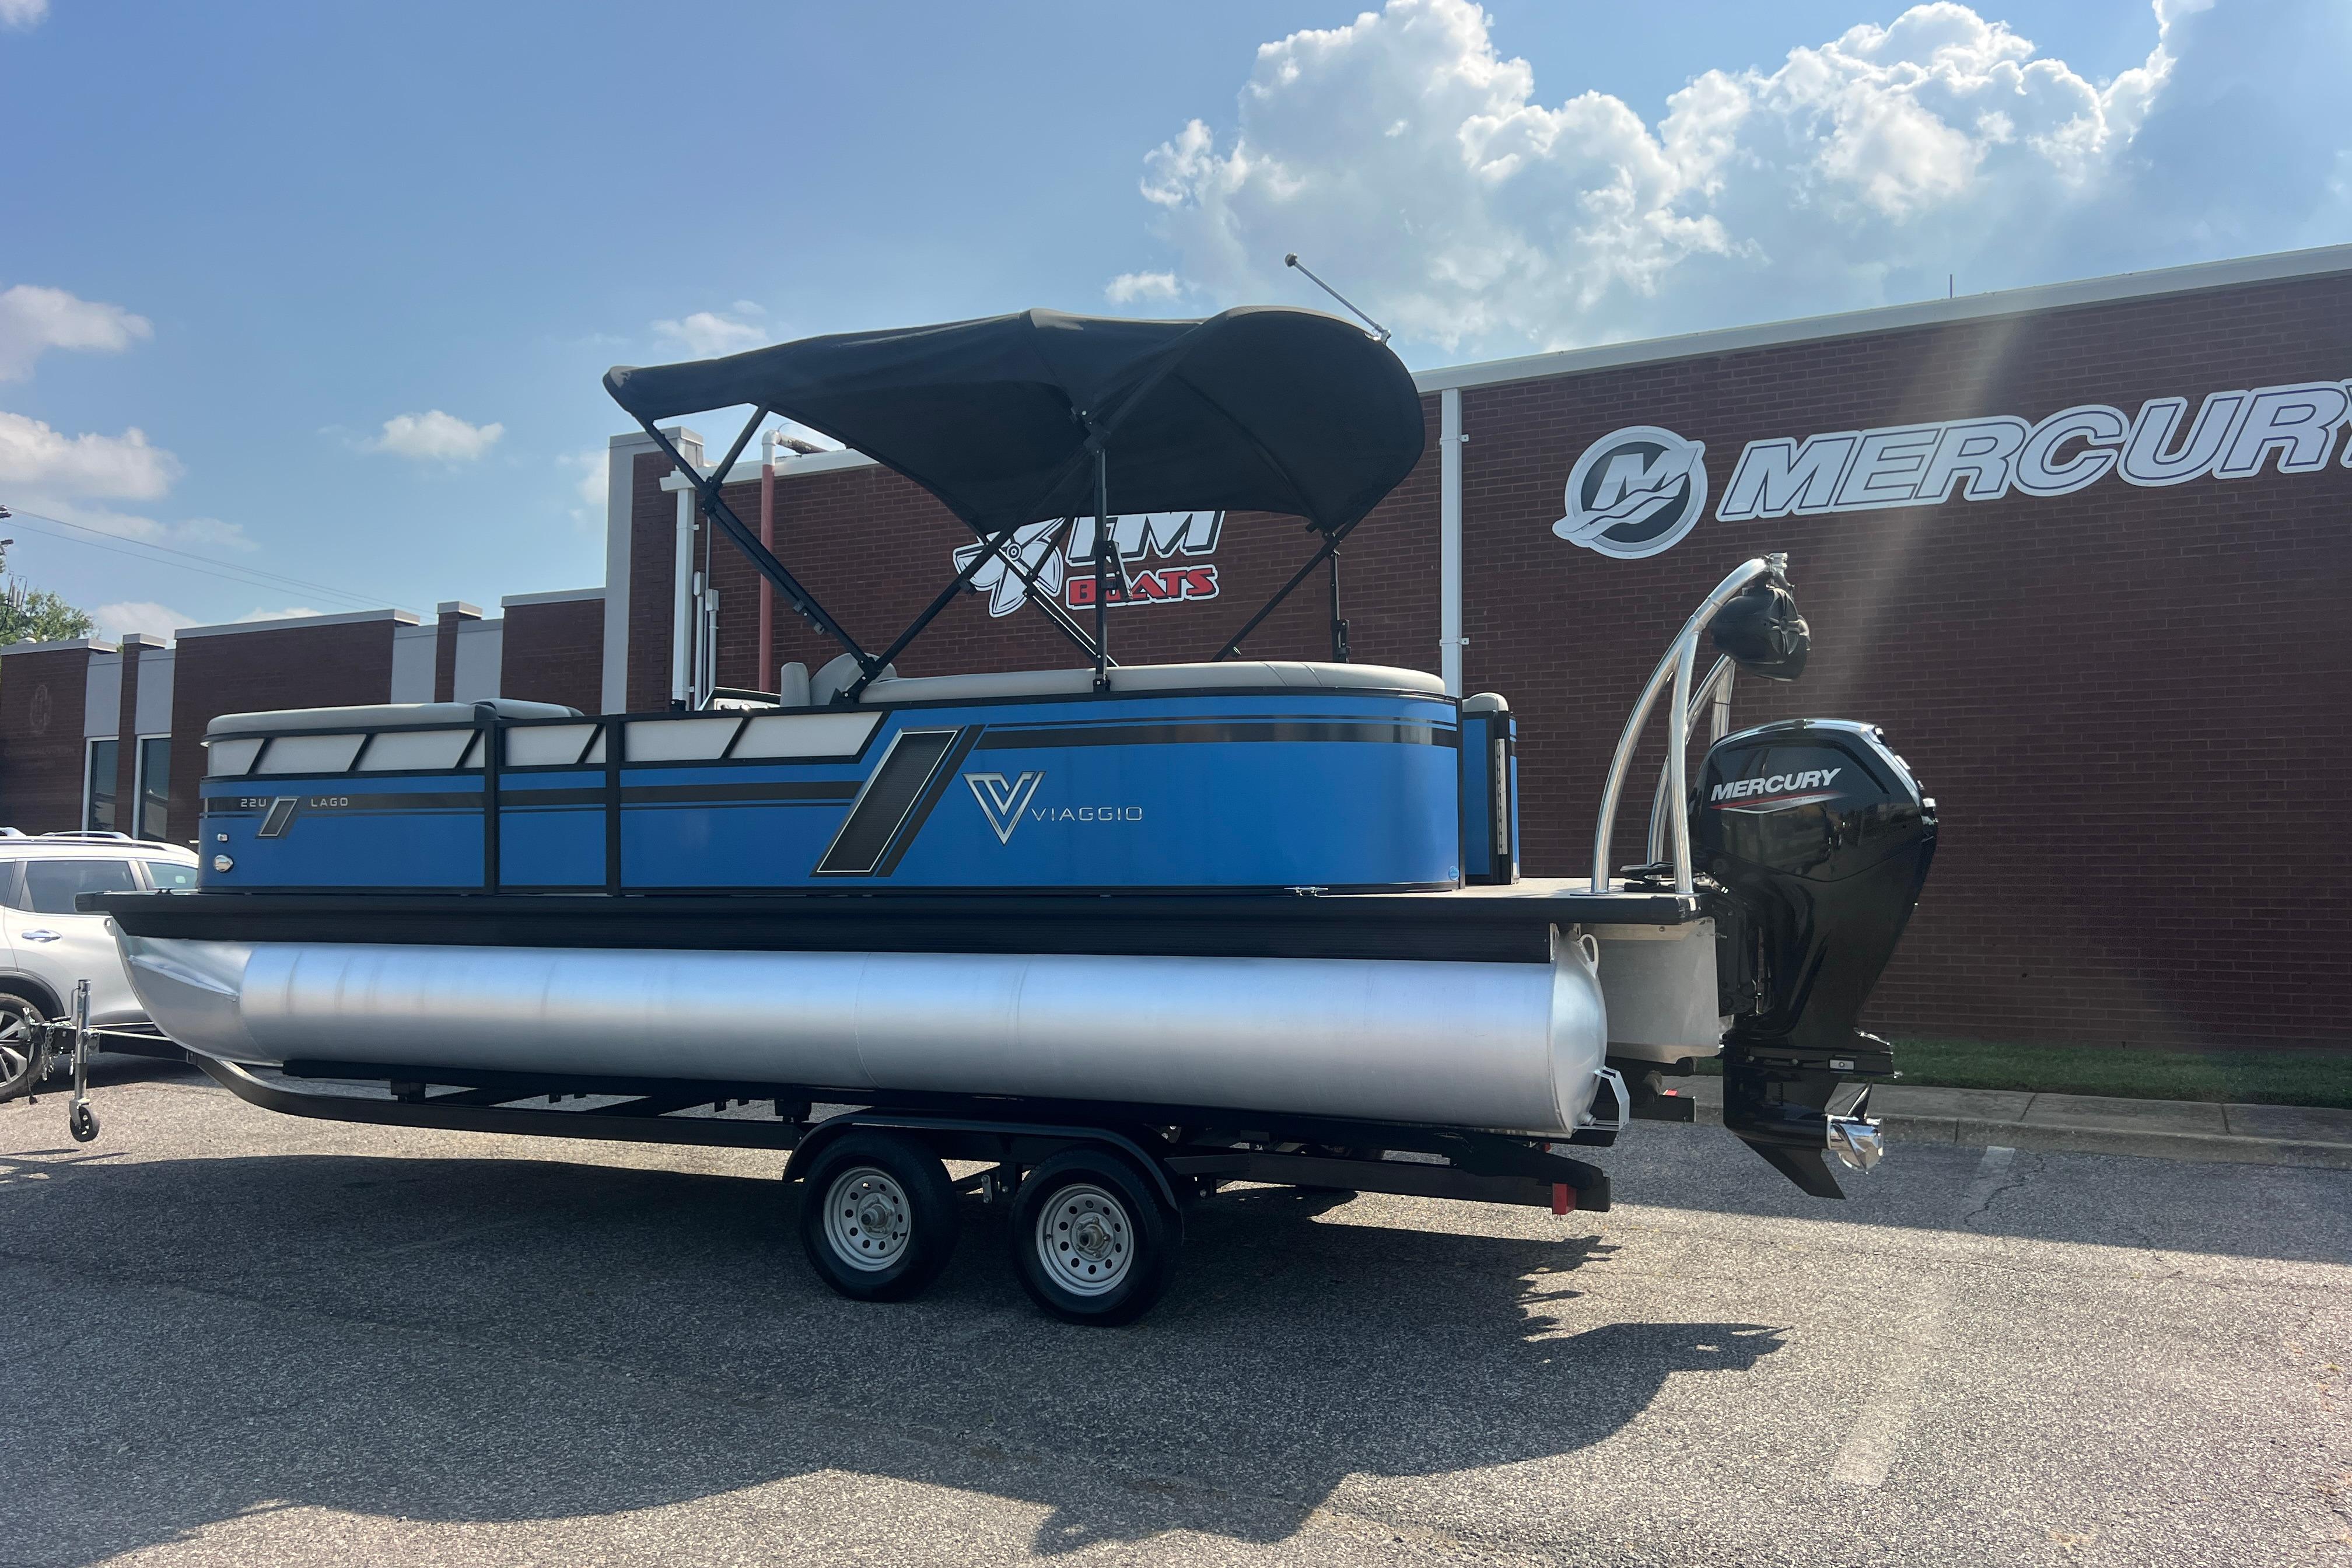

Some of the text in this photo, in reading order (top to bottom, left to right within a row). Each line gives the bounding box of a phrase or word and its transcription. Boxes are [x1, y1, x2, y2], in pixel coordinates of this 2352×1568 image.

[1718, 379, 2352, 520] MERCUR
[1710, 768, 1842, 802] MERCURY
[240, 797, 348, 808] 22U LAGO
[1031, 806, 1143, 822] VIAGGIO
